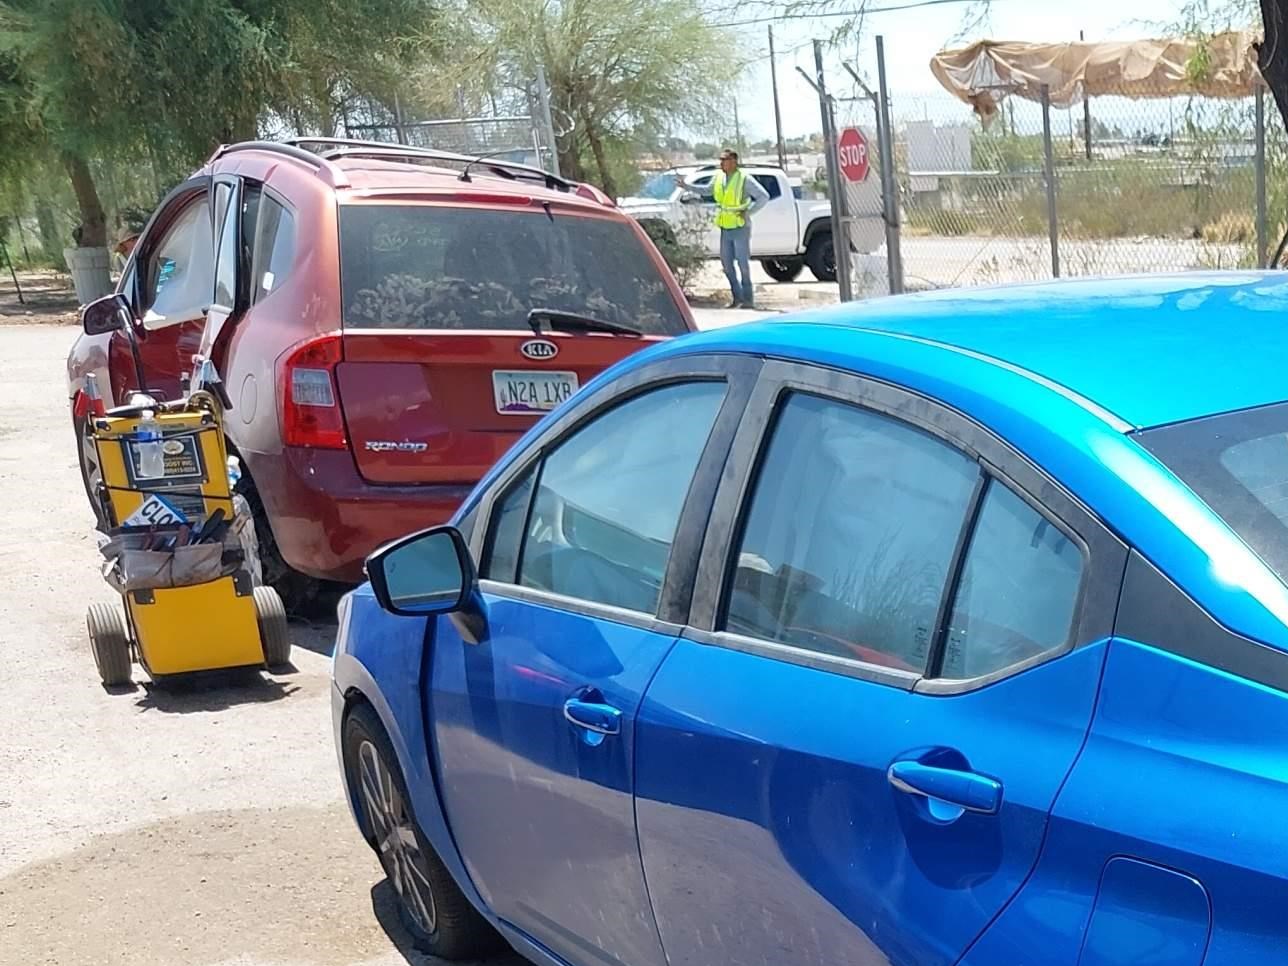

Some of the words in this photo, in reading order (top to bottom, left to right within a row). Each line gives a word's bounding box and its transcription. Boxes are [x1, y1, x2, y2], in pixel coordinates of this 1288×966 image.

[840, 144, 865, 167] STOP
[526, 343, 553, 356] KIA
[508, 381, 537, 402] N2A
